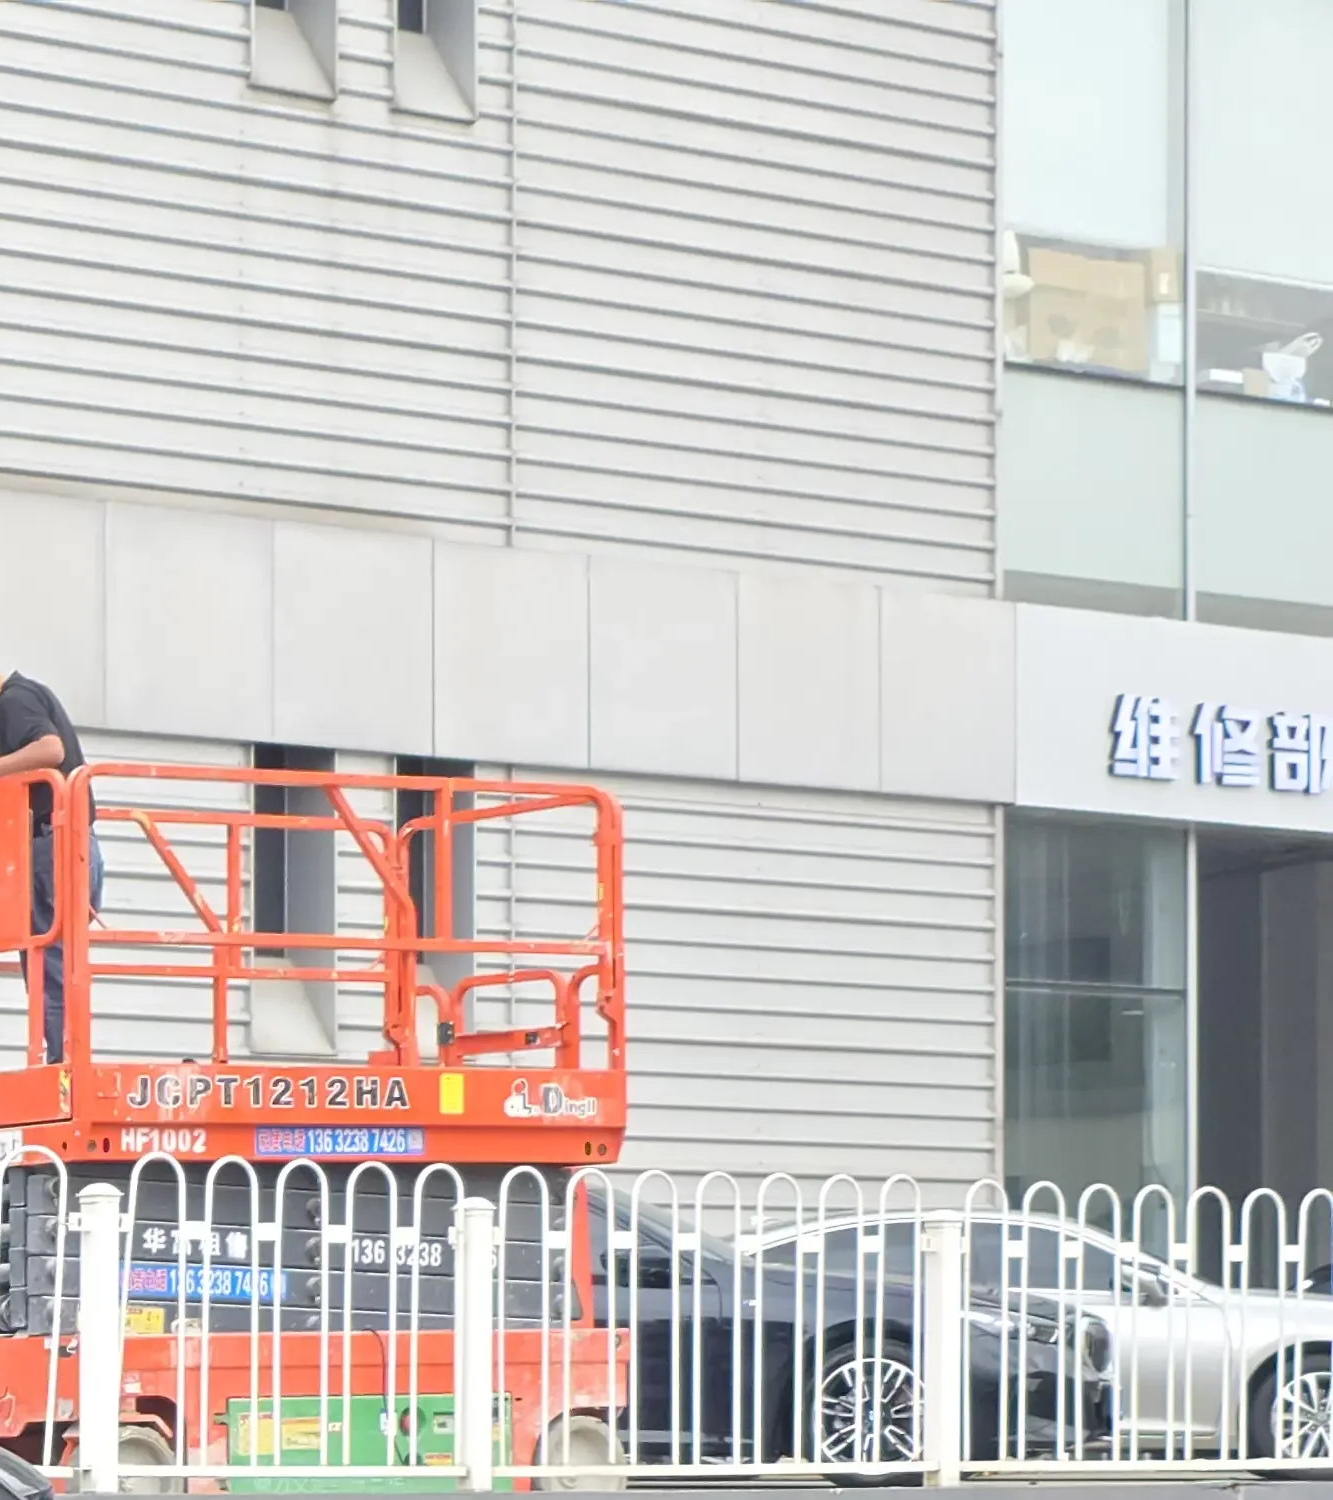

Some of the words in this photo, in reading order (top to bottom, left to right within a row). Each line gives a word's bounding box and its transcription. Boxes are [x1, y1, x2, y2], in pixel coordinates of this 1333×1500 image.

[1108, 693, 1333, 794] 维修部
[120, 1127, 207, 1153] HF1002
[308, 1128, 333, 1153] 136
[372, 1128, 406, 1153] 7426
[351, 1239, 386, 1264] 136
[169, 1268, 196, 1293] 16
[234, 1270, 269, 1297] 746
